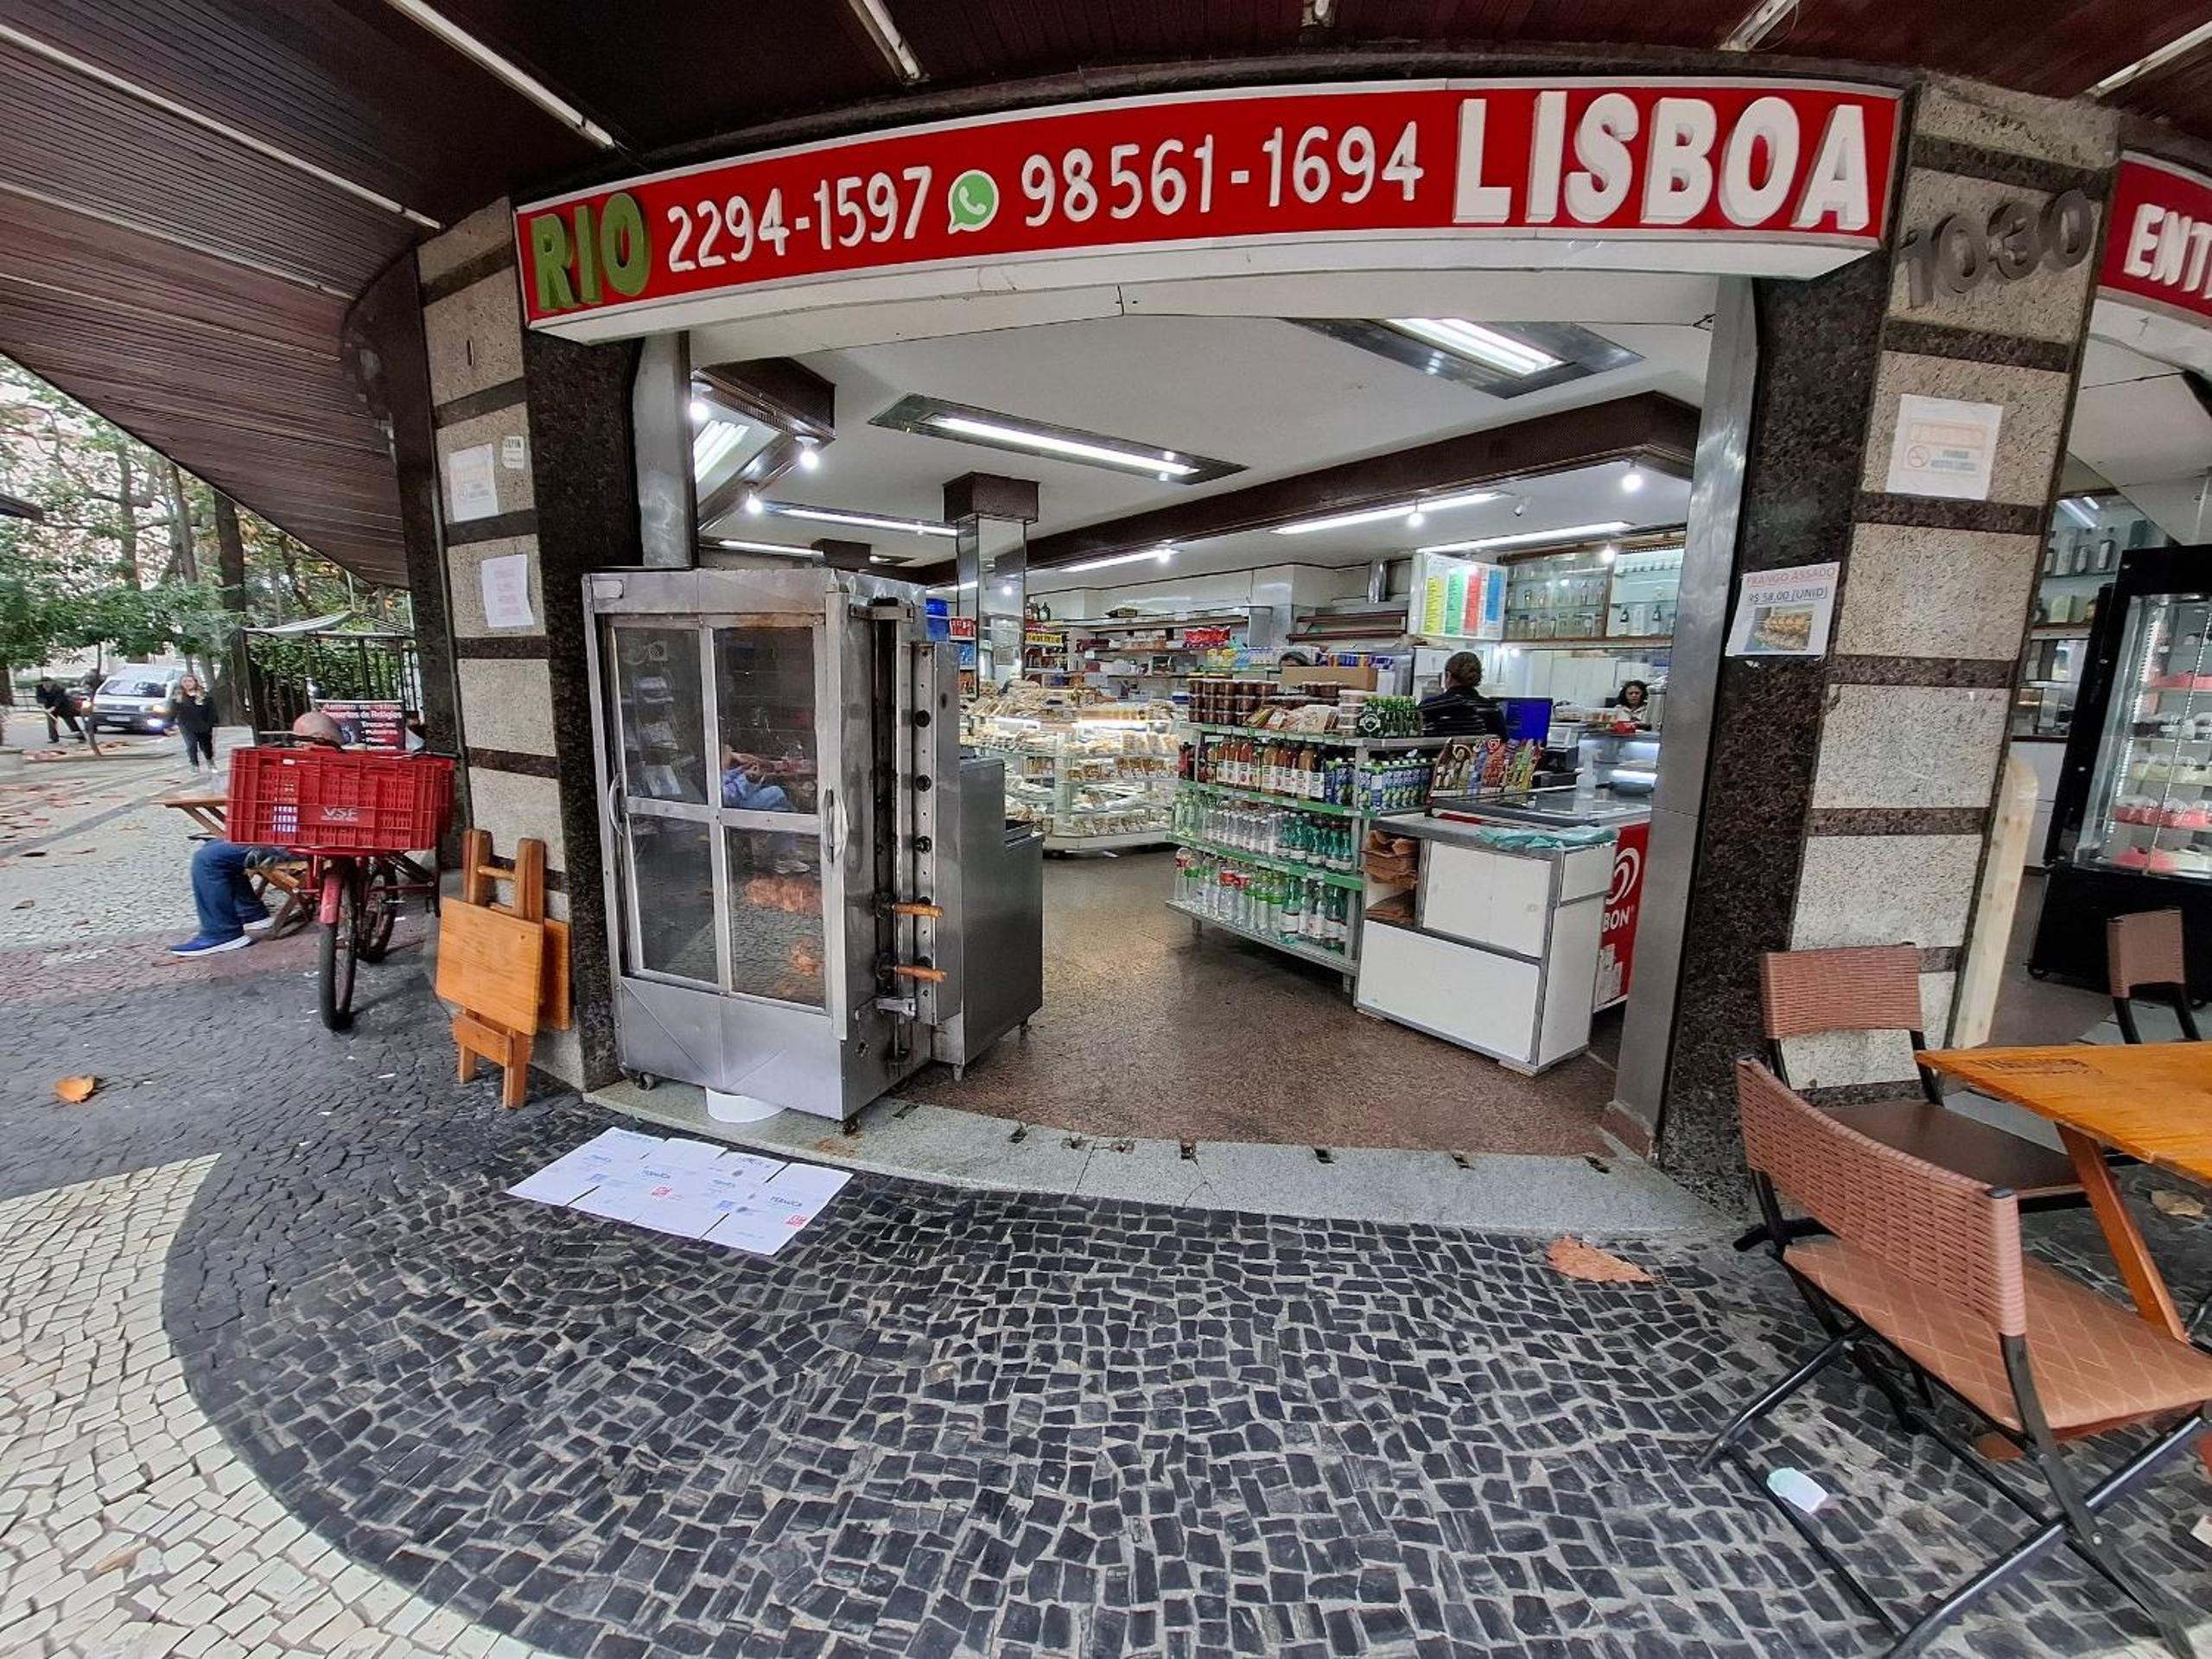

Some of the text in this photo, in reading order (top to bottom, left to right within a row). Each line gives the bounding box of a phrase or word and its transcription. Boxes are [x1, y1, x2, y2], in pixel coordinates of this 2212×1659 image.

[667, 121, 1424, 273] 2294-1597 98561-1694
[1452, 91, 1871, 231] LISBOA
[530, 192, 652, 312] RIO
[1899, 189, 2094, 308] 1030
[2123, 203, 2212, 299] ENT
